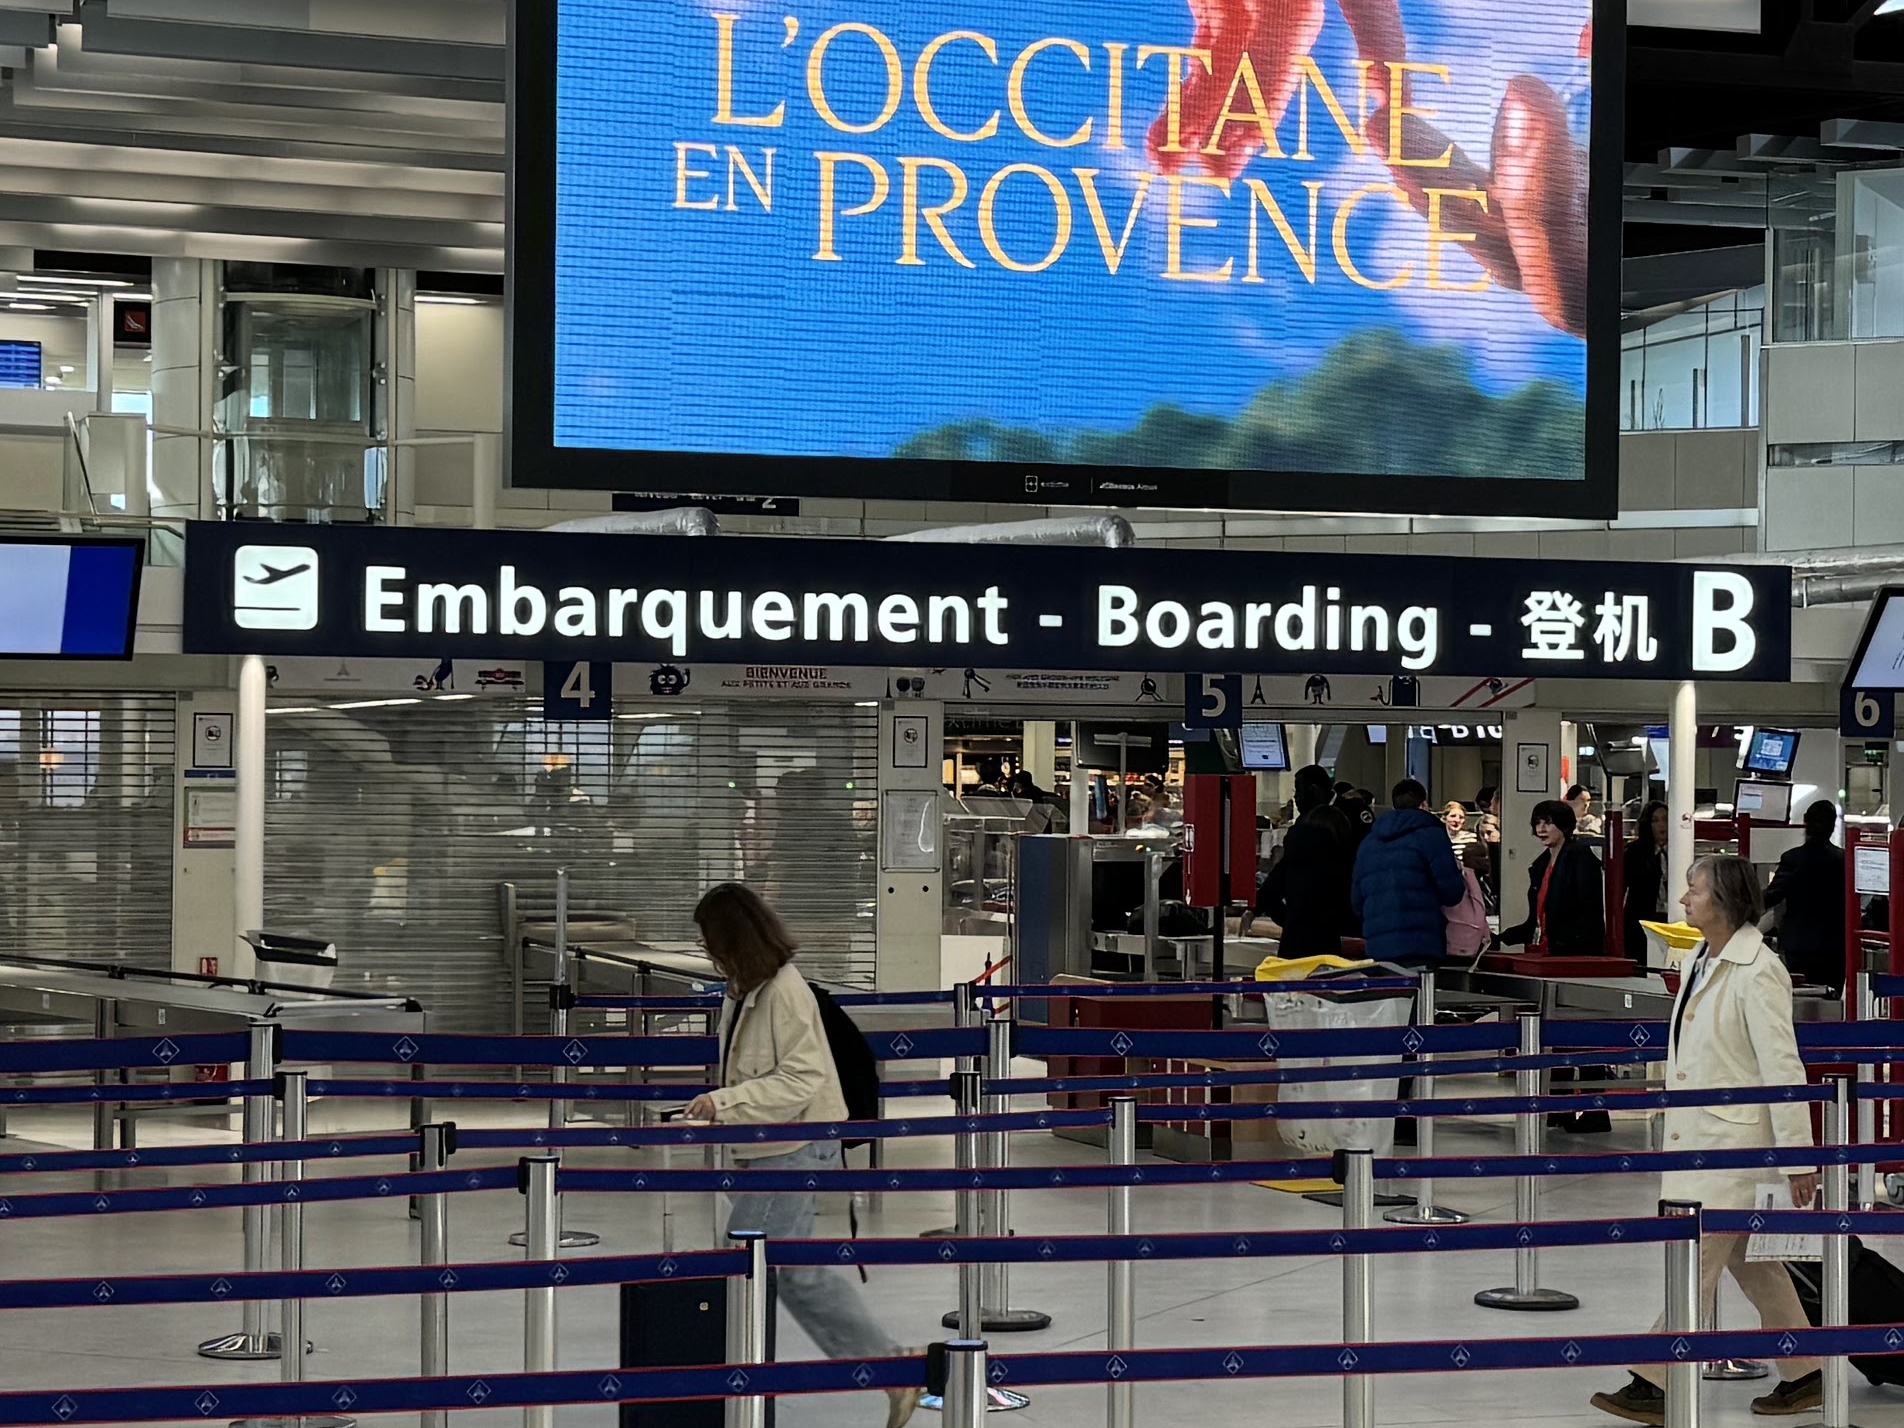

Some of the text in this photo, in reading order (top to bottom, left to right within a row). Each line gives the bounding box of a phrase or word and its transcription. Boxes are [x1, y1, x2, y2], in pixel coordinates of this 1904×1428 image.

[711, 12, 1456, 168] L'OCCITANE
[673, 141, 1494, 293] EN PROVENCE
[365, 564, 1010, 657] Embarquement
[1097, 584, 1438, 669] Boarding
[1521, 590, 1658, 663] 登机
[1692, 571, 1757, 672] B
[560, 661, 596, 708] 4
[746, 667, 827, 679] BIENVENUE
[1201, 673, 1227, 718] 5
[1854, 691, 1881, 727] 6
